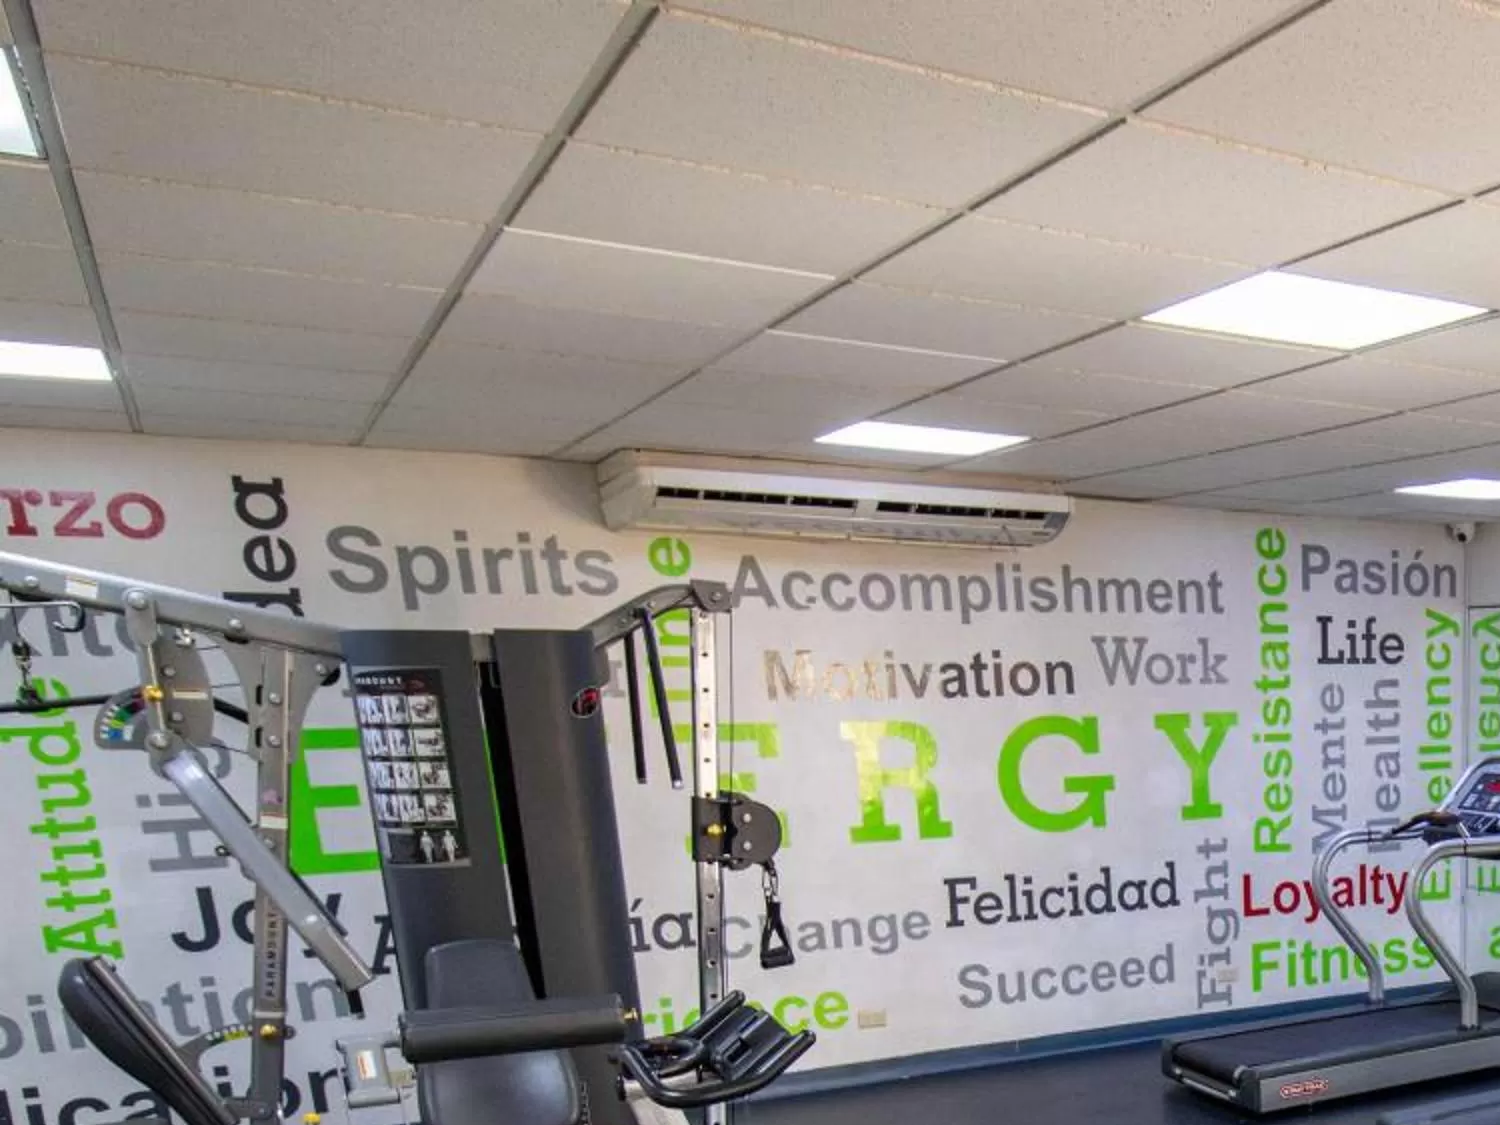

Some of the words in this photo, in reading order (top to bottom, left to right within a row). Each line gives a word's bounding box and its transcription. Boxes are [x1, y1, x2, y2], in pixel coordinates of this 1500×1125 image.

[324, 523, 620, 610] Spirits
[729, 553, 1227, 626] Accomplishment
[1300, 543, 1458, 598] Pasión
[1091, 635, 1231, 689] Work
[1315, 615, 1406, 666] Life
[762, 648, 1076, 702] Motivation
[1253, 526, 1295, 855] Resistance
[942, 861, 1180, 929] Felicidad
[1195, 837, 1240, 1009] Fight
[1242, 863, 1408, 923] Loyalty
[956, 942, 1178, 1011] Succeed
